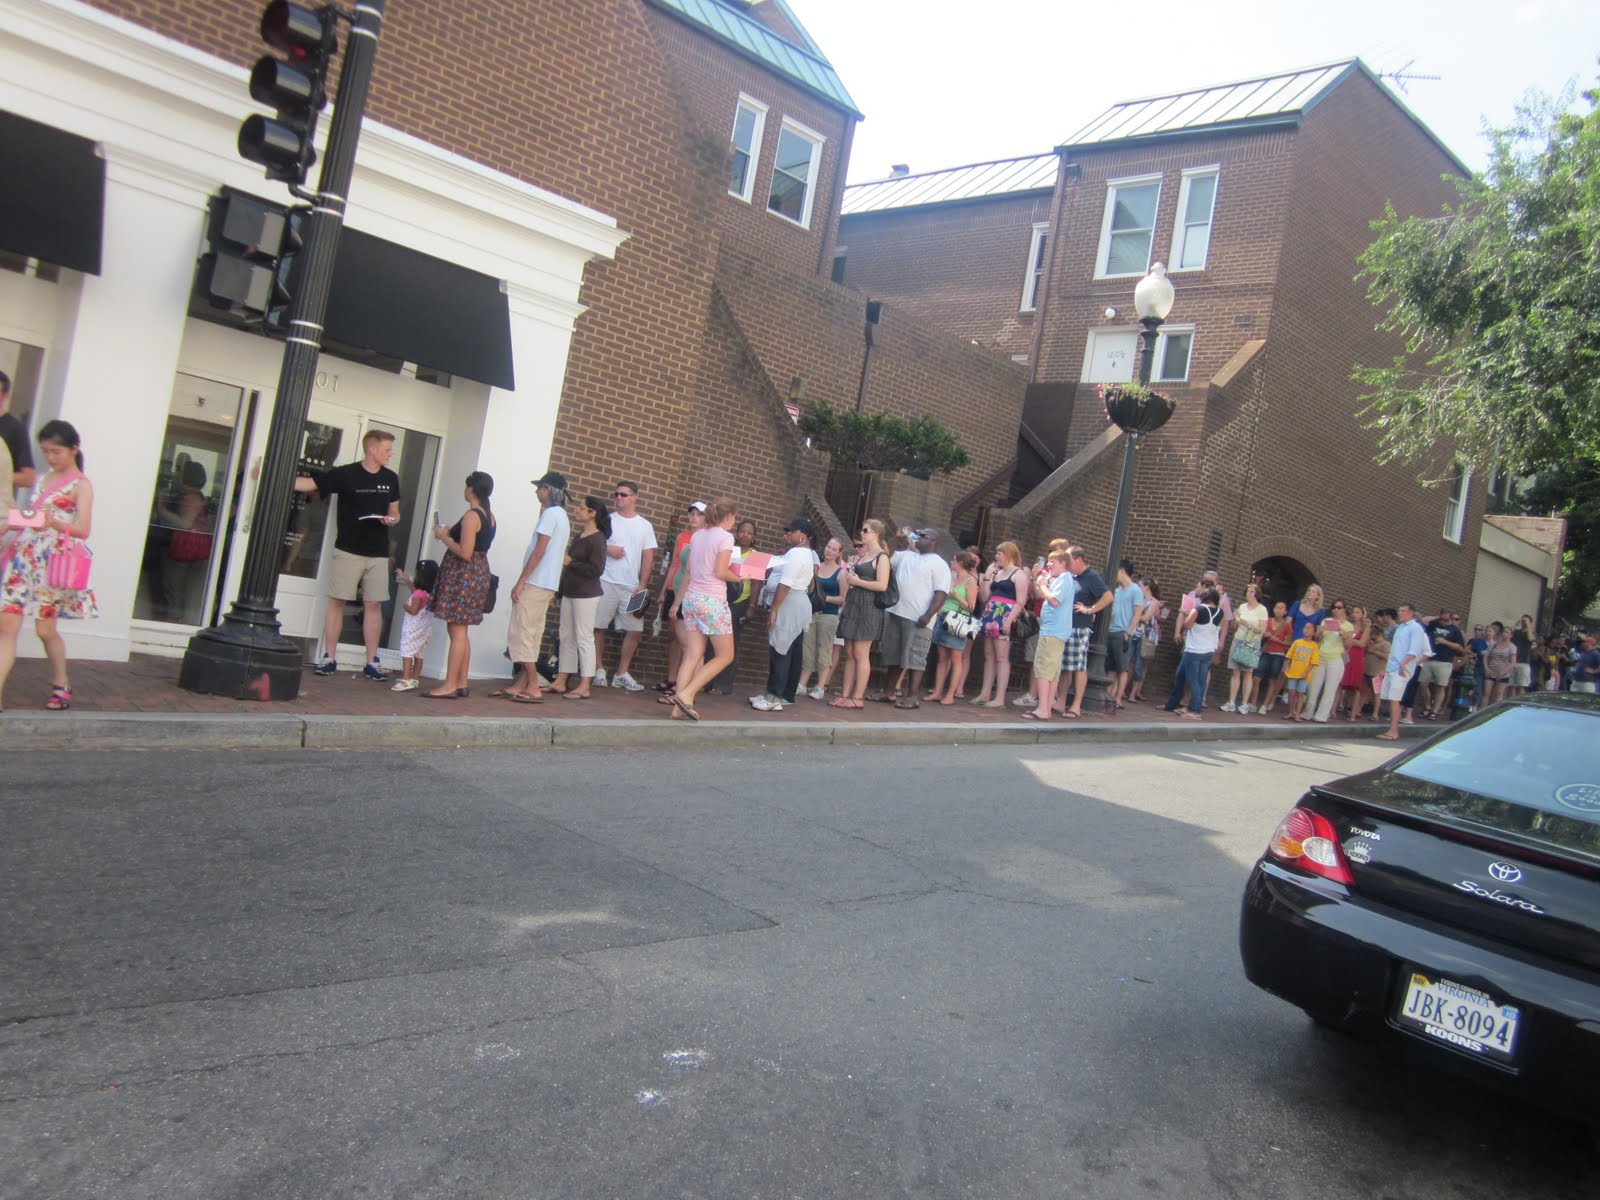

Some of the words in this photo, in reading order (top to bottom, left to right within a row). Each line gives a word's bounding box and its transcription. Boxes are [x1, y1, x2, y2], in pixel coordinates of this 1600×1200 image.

[1350, 826, 1380, 841] TOYOTA
[1453, 880, 1544, 914] Solara
[1437, 983, 1490, 1008] VIRGINIA
[1408, 989, 1510, 1047] JBK-8094
[1424, 1024, 1484, 1052] KOONS
